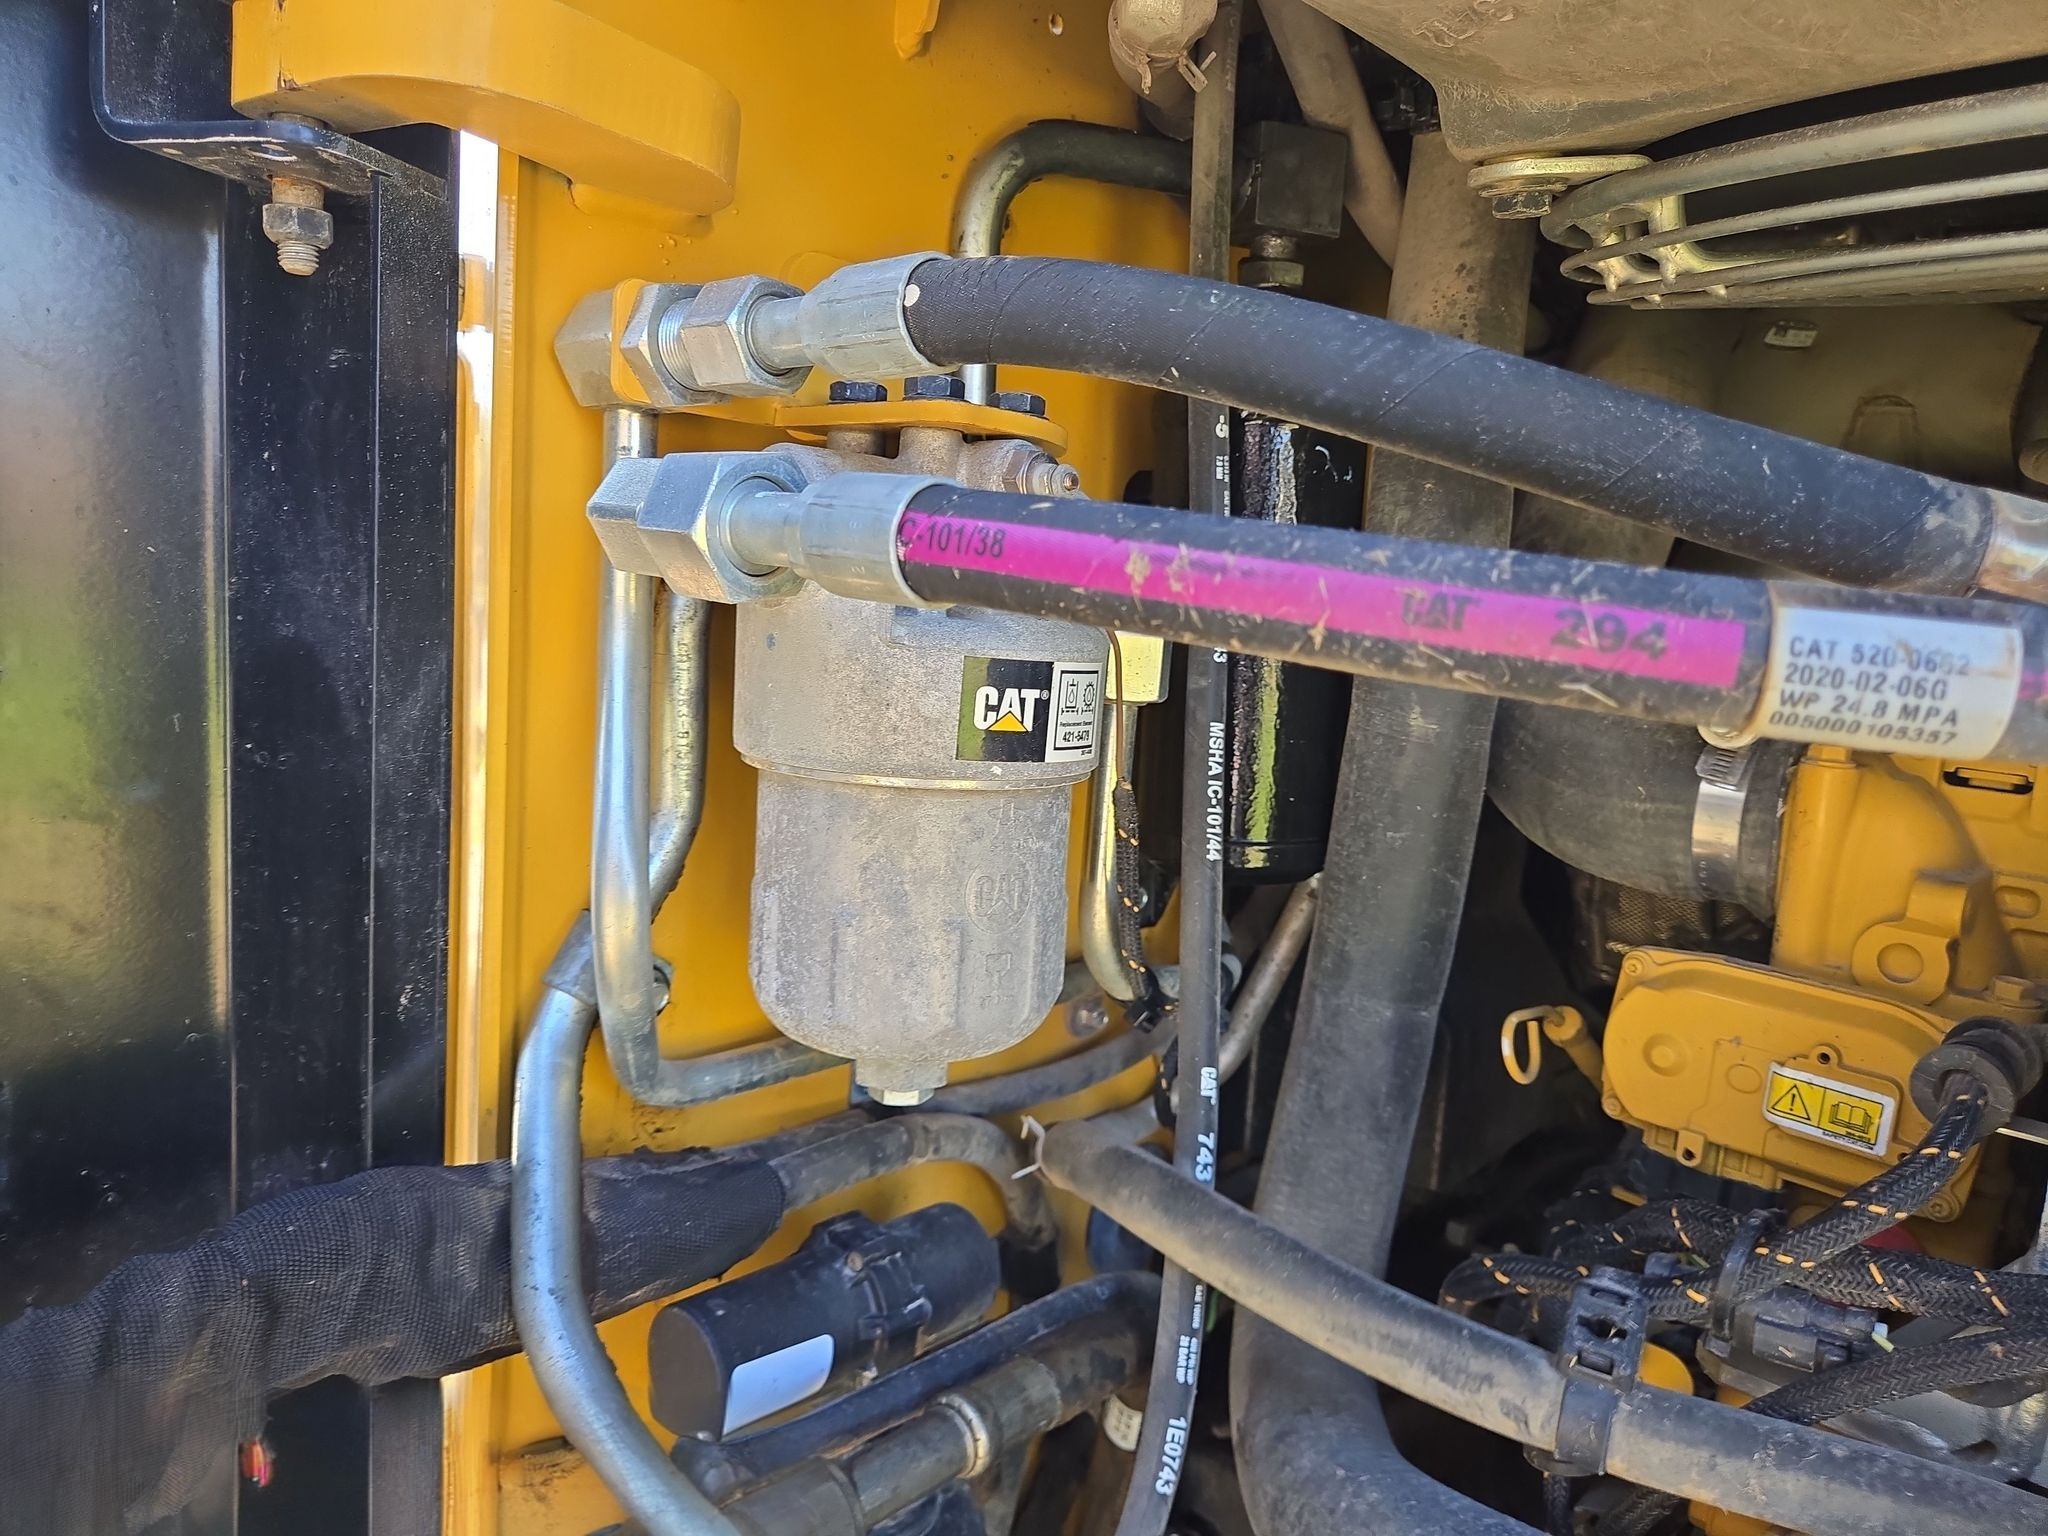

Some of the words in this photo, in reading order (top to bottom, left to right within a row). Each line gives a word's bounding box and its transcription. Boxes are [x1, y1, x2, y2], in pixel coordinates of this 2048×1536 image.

[1550, 605, 1669, 658] 294
[1789, 635, 1839, 661] CAT
[1779, 688, 1821, 711] WP
[1831, 694, 1889, 720] 24.8
[1897, 704, 1959, 728] MPA
[1207, 721, 1226, 777] MSHA
[1204, 780, 1225, 862] IC-101/44
[1199, 1066, 1219, 1101] CAT
[1193, 1132, 1216, 1182] 743
[1154, 1416, 1188, 1496] 1E0743
